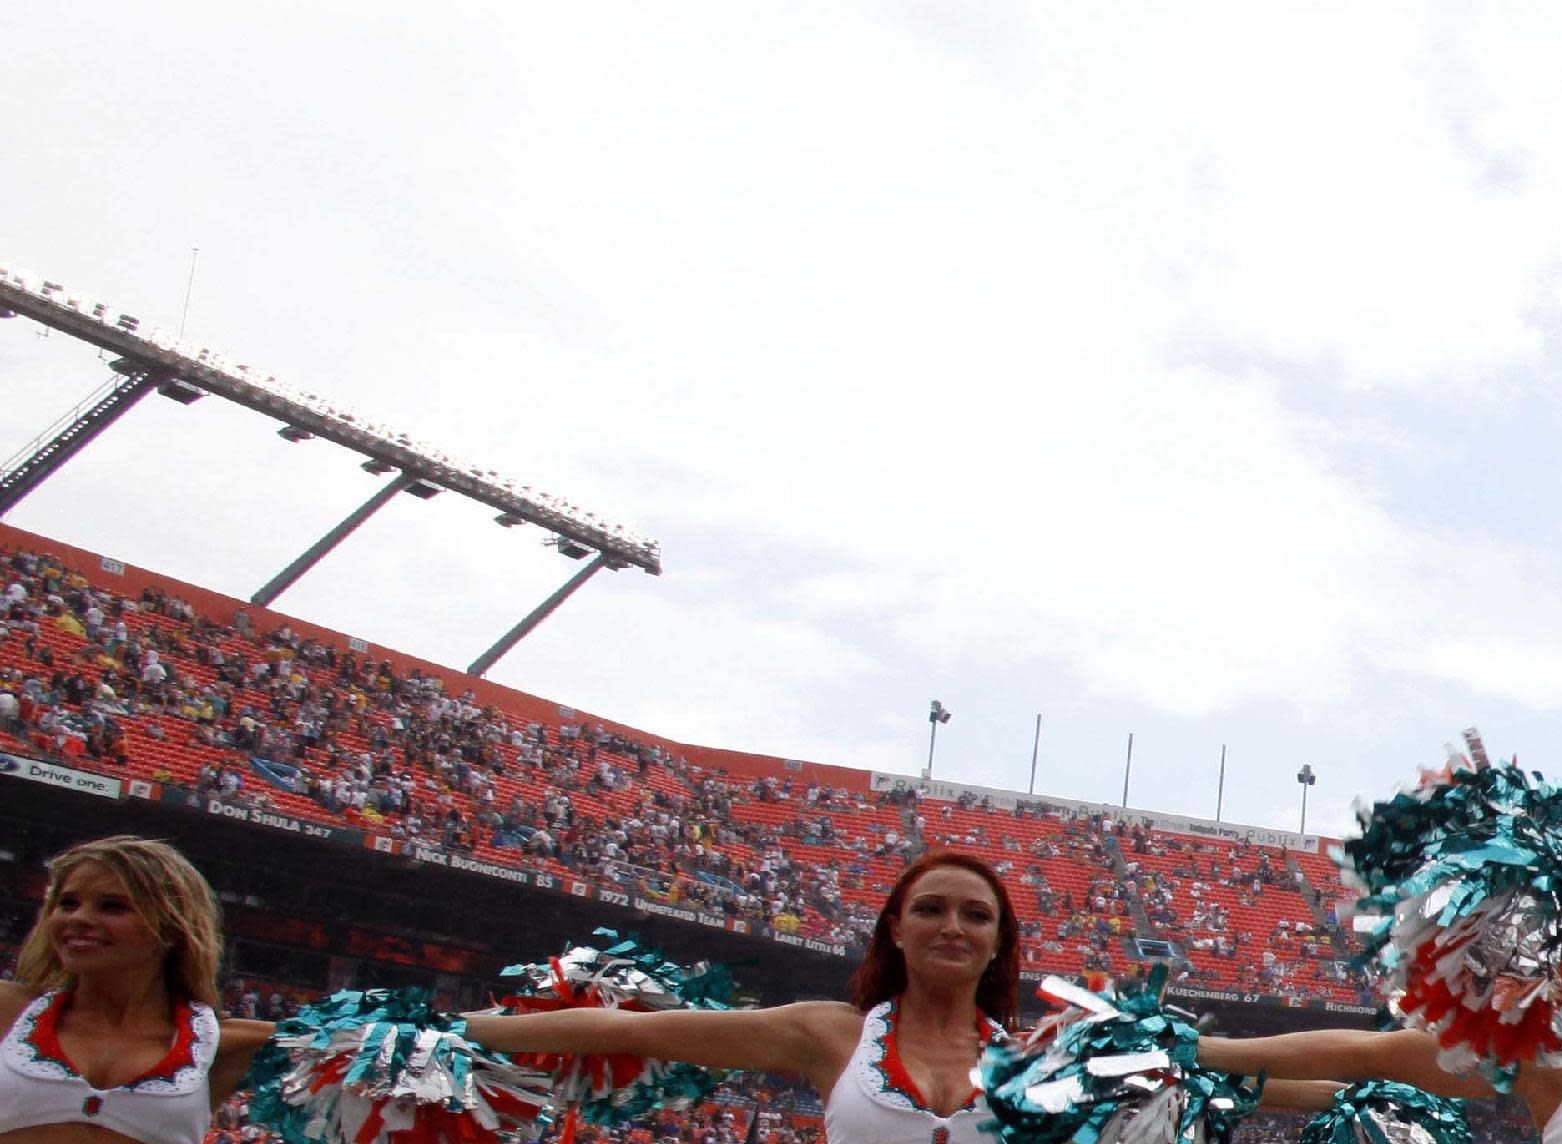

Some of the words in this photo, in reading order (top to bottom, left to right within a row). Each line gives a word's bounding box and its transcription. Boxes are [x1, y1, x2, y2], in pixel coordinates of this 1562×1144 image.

[30, 765, 72, 784] Drive
[77, 778, 109, 793] one.
[208, 800, 249, 821] DON
[250, 809, 300, 832] SHULA
[304, 824, 332, 838] 347
[1247, 829, 1297, 847] Publix
[415, 847, 448, 866] NICK
[451, 855, 527, 883] BUONICONTI
[600, 890, 629, 906] 1972
[634, 898, 697, 921] UNDEFEATED
[698, 912, 725, 928] TEAM
[1167, 985, 1239, 1002] KUECHENBERG
[1243, 993, 1260, 1003] 67
[1325, 1001, 1378, 1016] RICHMOND
